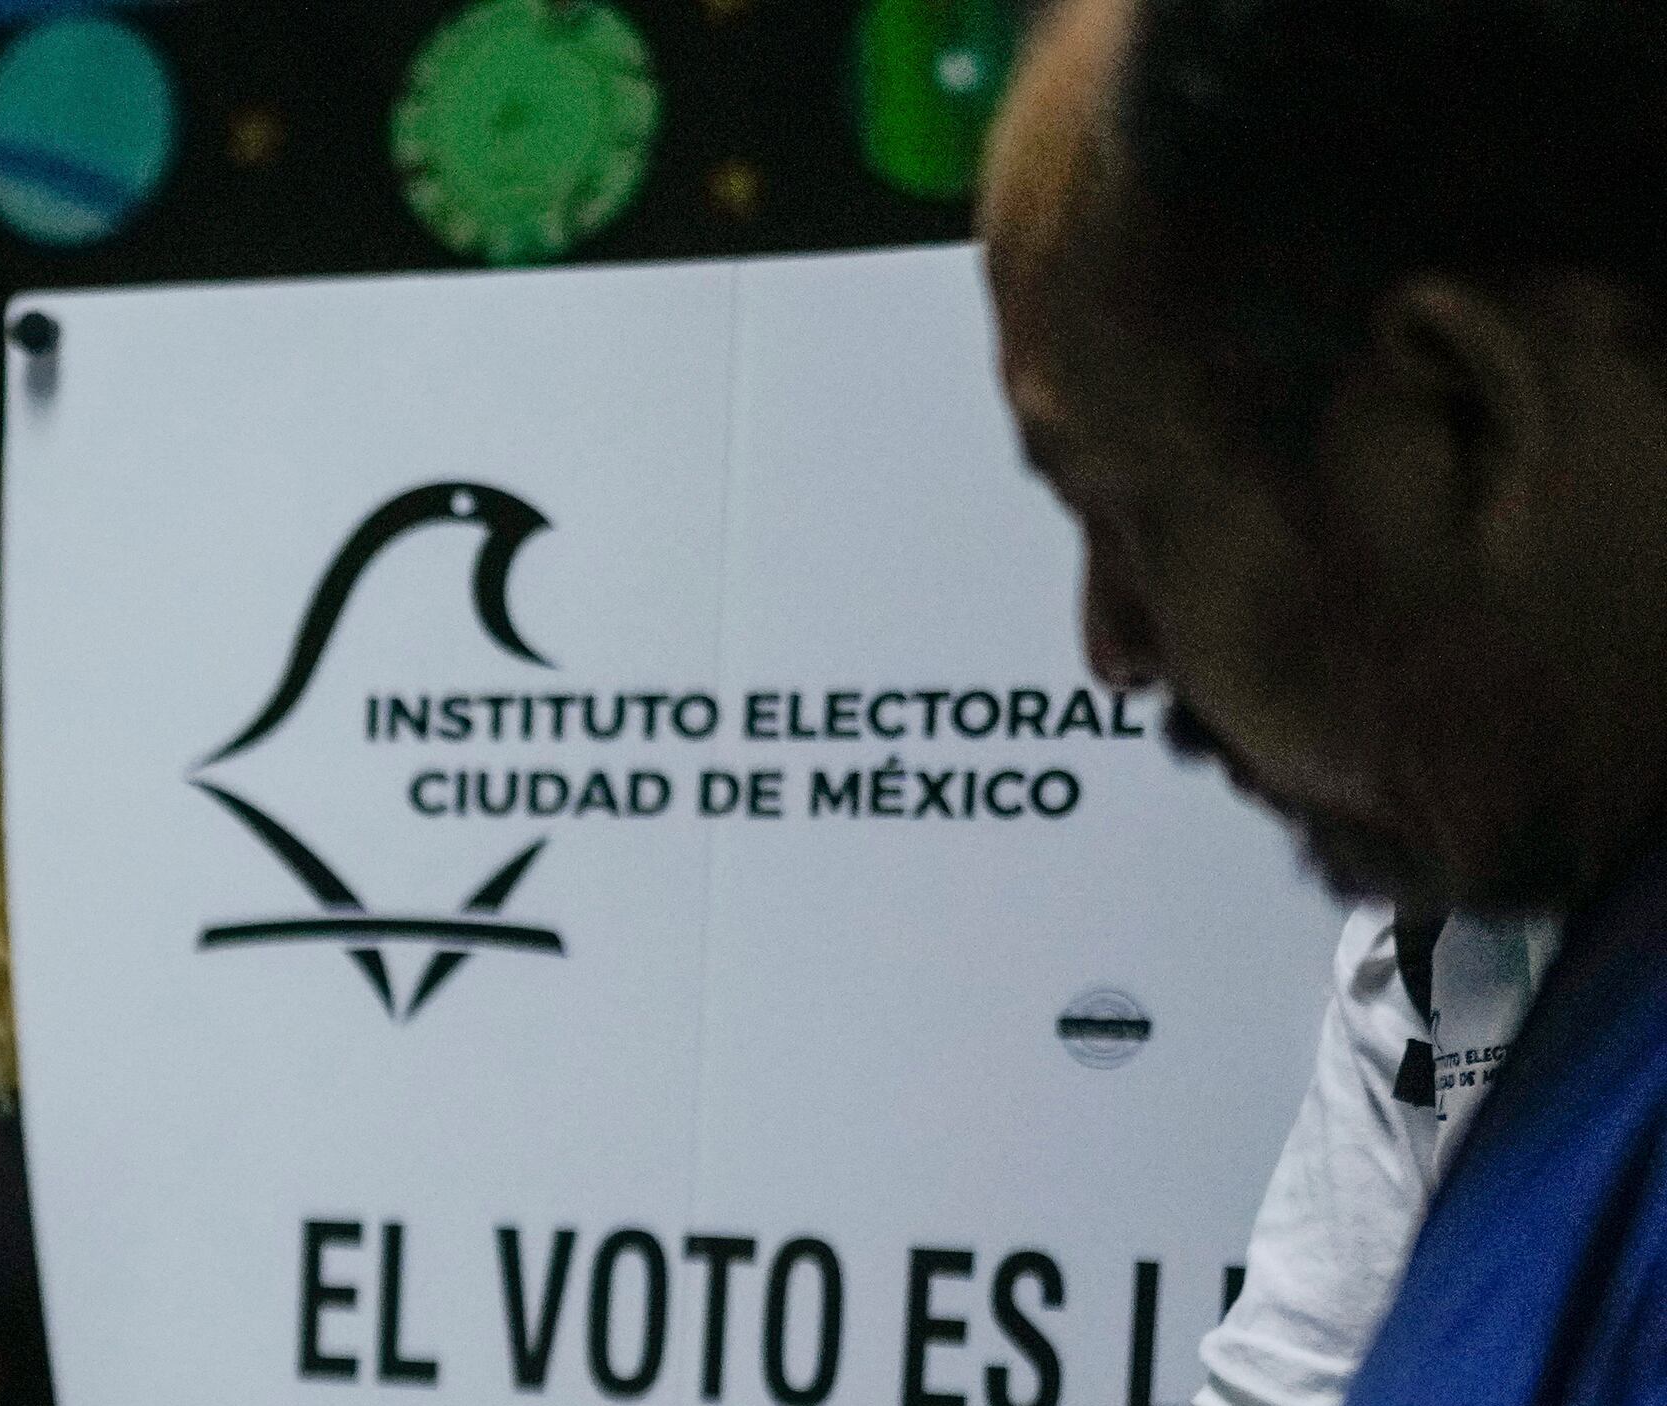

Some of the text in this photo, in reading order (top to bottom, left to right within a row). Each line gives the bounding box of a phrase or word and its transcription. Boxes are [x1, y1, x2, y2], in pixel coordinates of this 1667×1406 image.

[368, 682, 1149, 739] INSTITUTO ELECTORAL
[410, 757, 1080, 818] CIUDAD DE MÉXICO
[299, 1221, 438, 1384] EL
